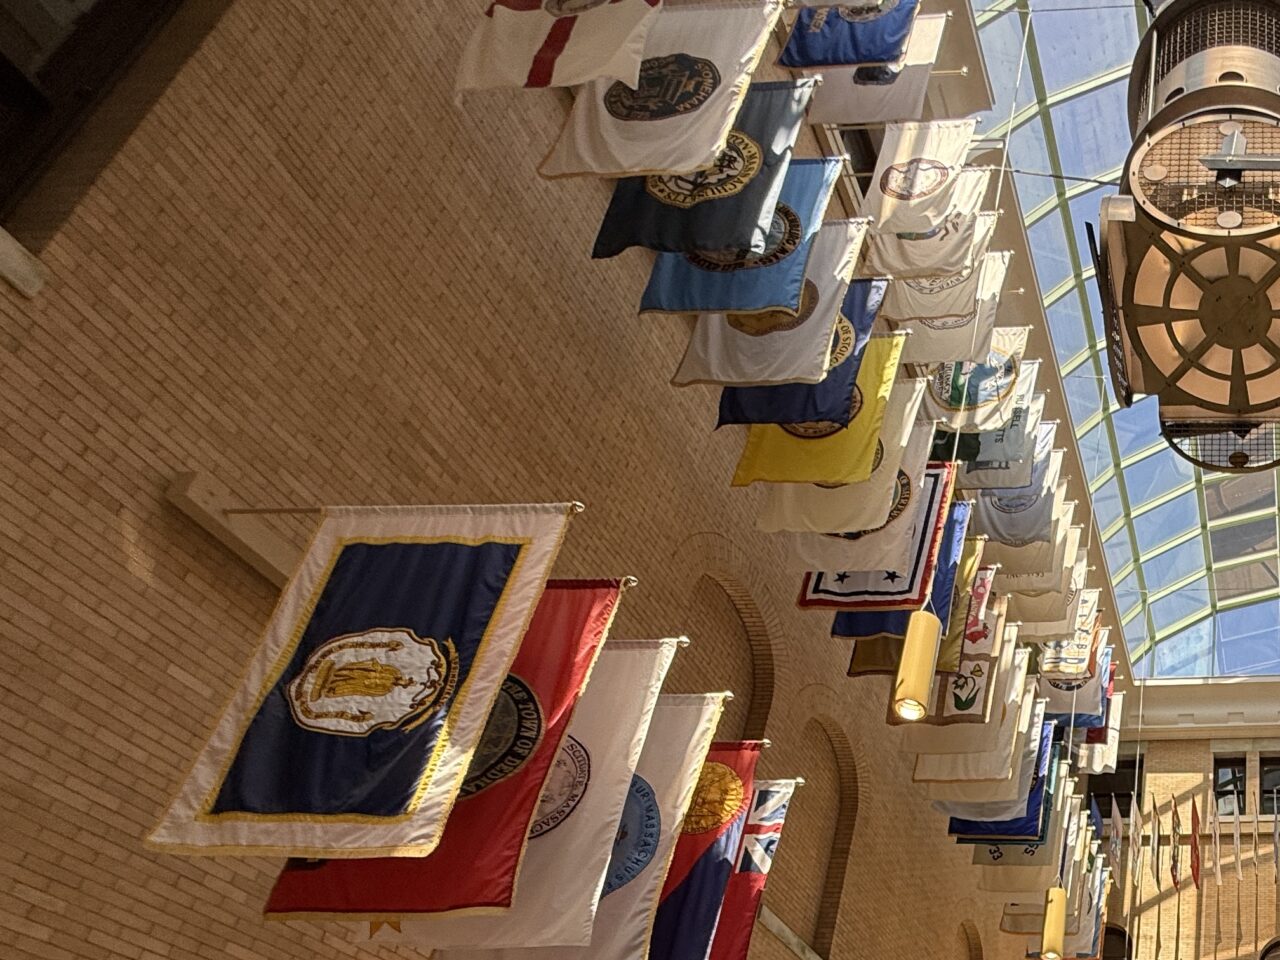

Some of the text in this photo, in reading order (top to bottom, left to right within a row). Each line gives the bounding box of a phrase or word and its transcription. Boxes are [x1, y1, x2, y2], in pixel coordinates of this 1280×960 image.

[675, 63, 714, 112] STONEHAM
[840, 324, 852, 336] OF
[518, 702, 538, 738] TOWN
[512, 739, 533, 756] OF
[462, 757, 522, 793] DEDHA
